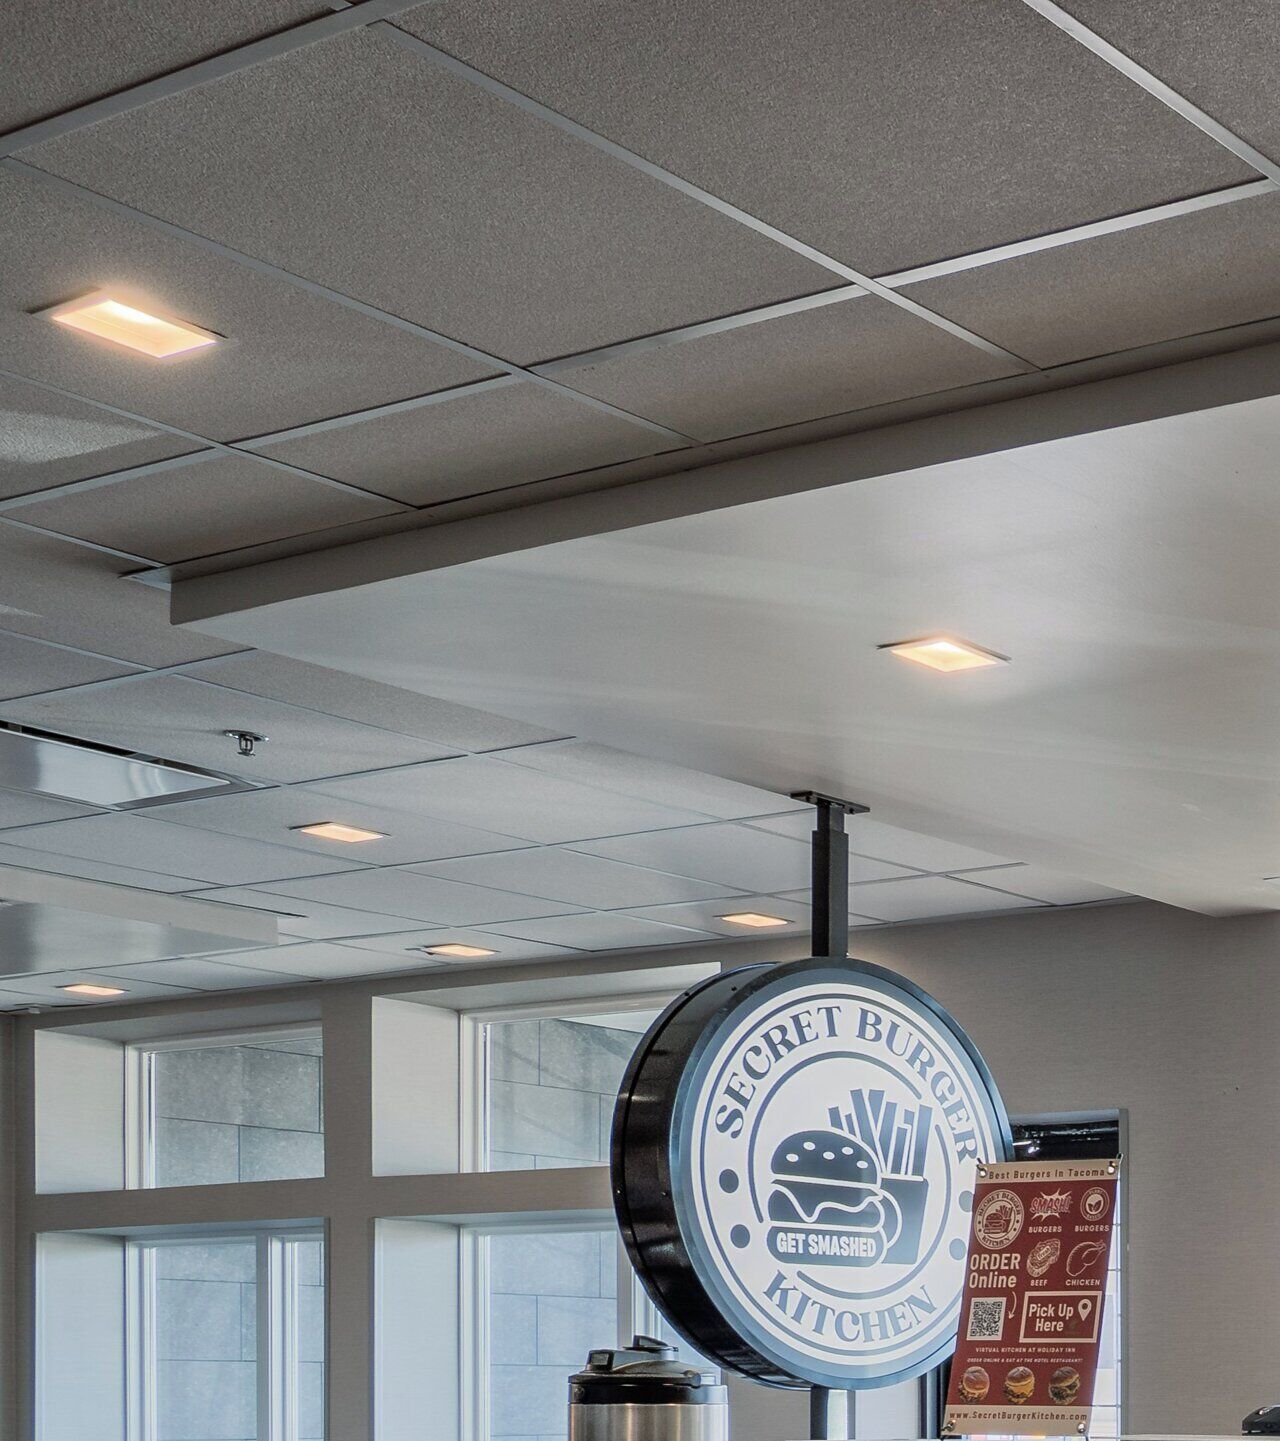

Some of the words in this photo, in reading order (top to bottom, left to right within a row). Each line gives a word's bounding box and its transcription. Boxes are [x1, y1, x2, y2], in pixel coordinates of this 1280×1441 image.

[715, 1006, 842, 1139] SECRET
[856, 1007, 979, 1164] BURGER
[988, 1171, 1010, 1180] Best
[1013, 1170, 1051, 1181] Burgers
[1068, 1168, 1105, 1178] Tacoma
[1028, 1225, 1063, 1234] BURGERS
[1074, 1224, 1110, 1233] BURGERS
[776, 1231, 806, 1254] GET
[808, 1234, 877, 1258] SMASHED
[970, 1253, 1021, 1271] ORDER
[969, 1271, 1017, 1288] Online
[1030, 1279, 1048, 1287] BEEF
[1065, 1278, 1100, 1286] CHICKEN
[763, 1269, 937, 1343] KITCHEN
[1028, 1304, 1055, 1318] Pick
[1058, 1304, 1074, 1320] Up
[1035, 1319, 1064, 1332] Here
[949, 1410, 1088, 1421] www.SecretBurgerKitchen.com
